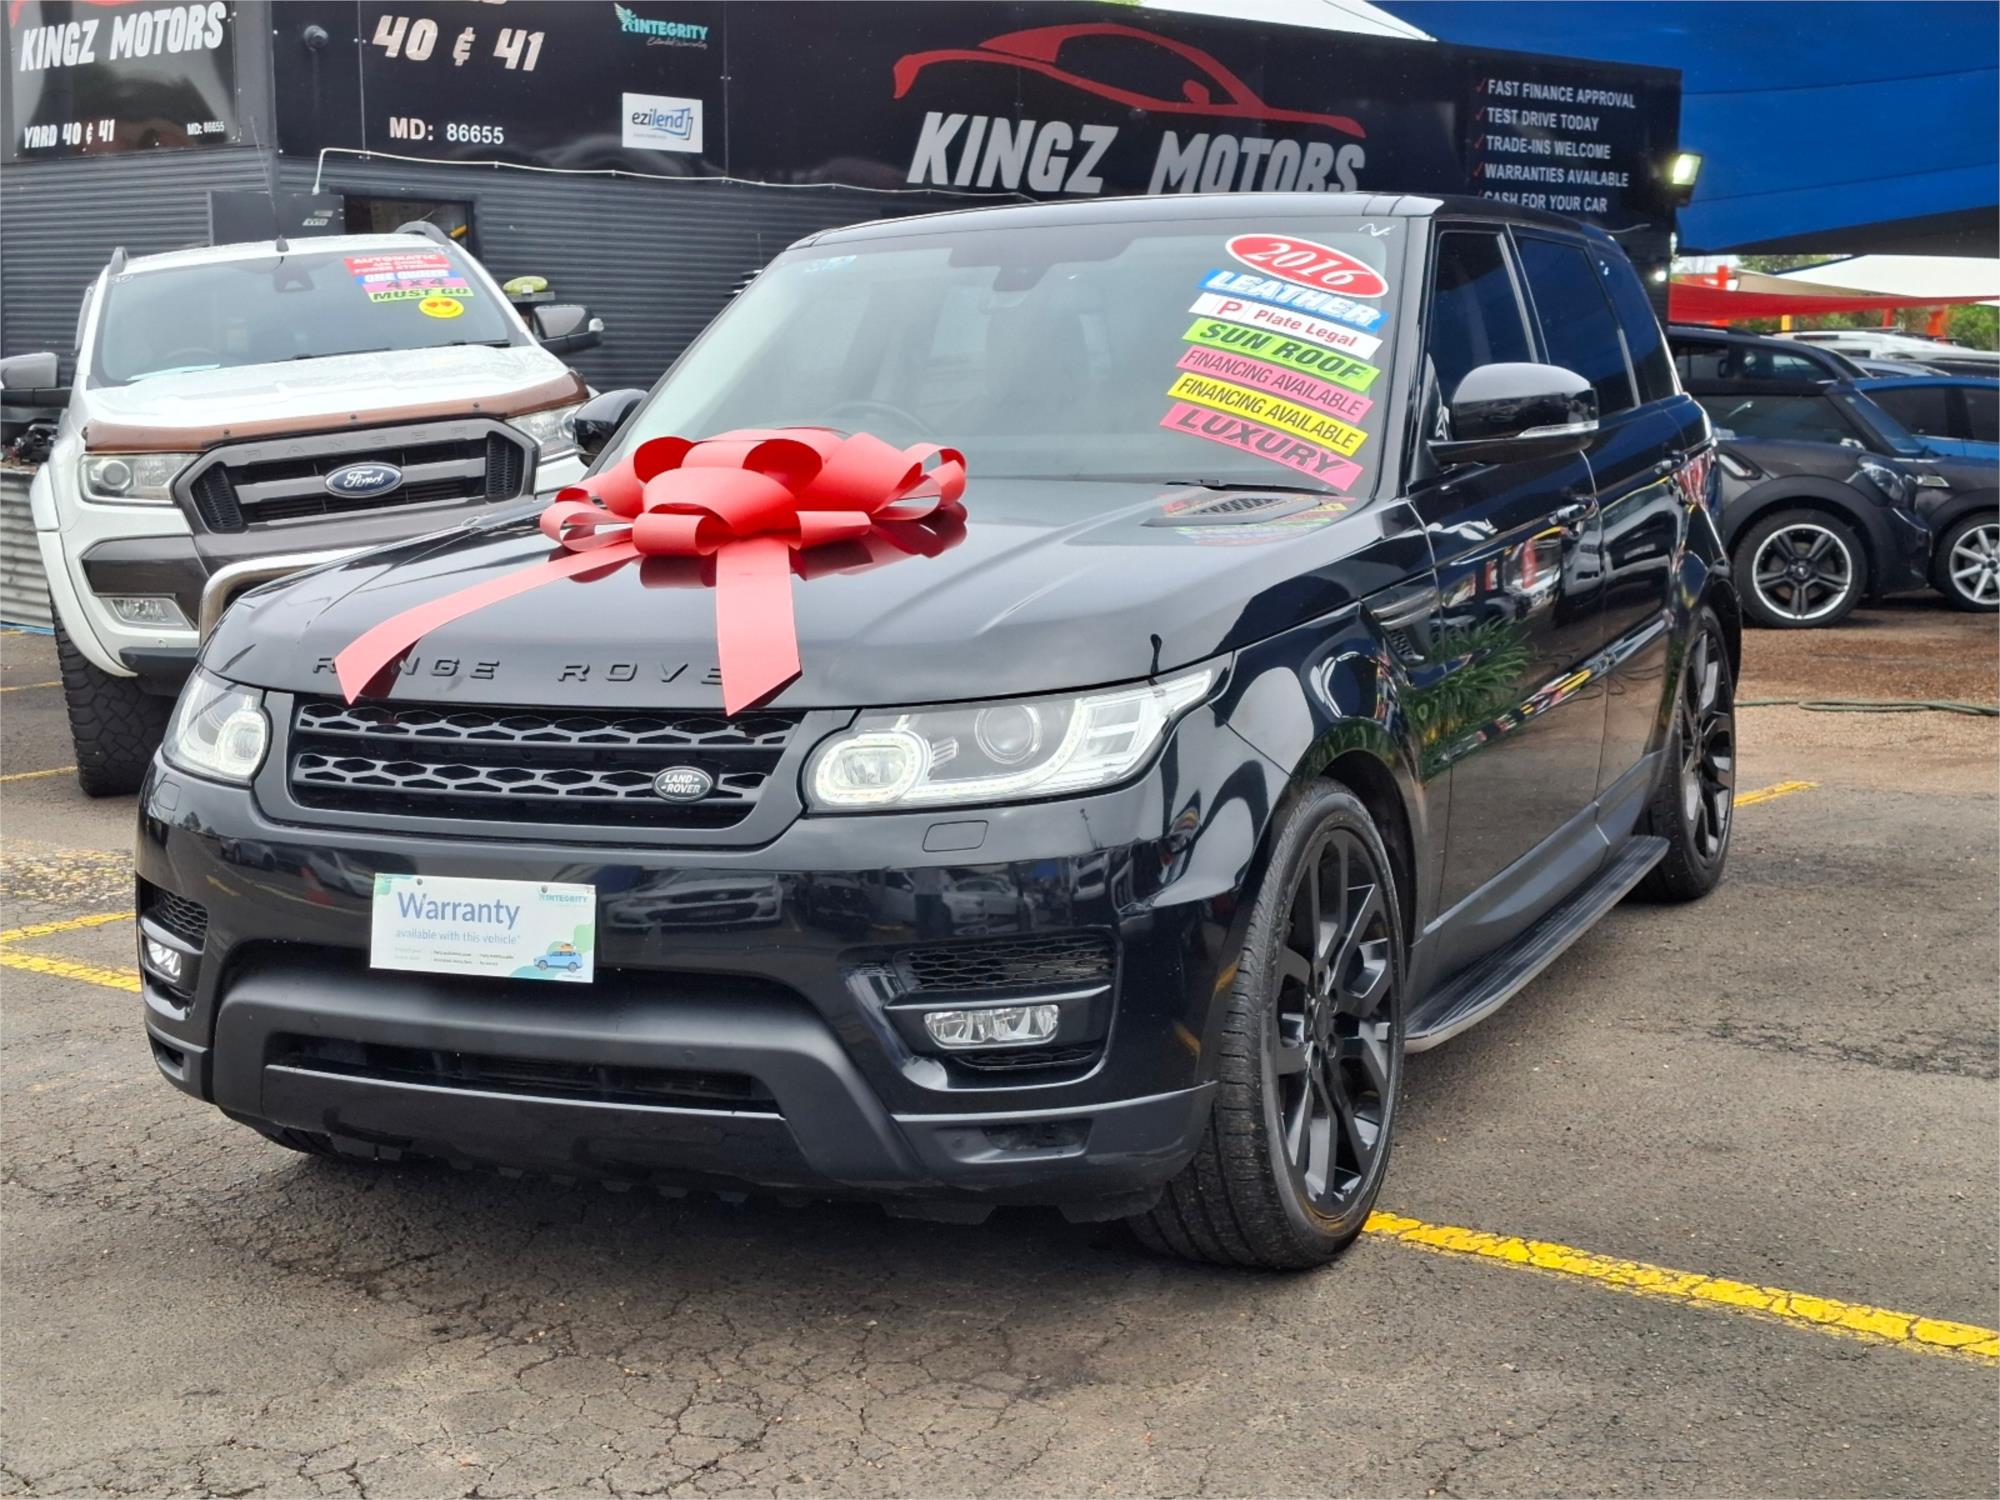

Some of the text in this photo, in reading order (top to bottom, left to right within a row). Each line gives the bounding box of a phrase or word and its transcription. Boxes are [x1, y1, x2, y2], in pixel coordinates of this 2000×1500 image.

[20, 1, 227, 72] KINGZ MOTORS
[372, 15, 439, 61] 40
[492, 28, 546, 72] 41
[634, 17, 709, 40] INTEGRITY
[1487, 79, 1636, 109] FAST FINANCE APPROVAL
[24, 124, 58, 149] YARD
[62, 122, 82, 145] 40
[98, 118, 116, 142] 41
[389, 116, 505, 145] MD: 86655
[631, 107, 686, 129] ezilend
[1486, 107, 1600, 132] TEST DRIVE TODAY
[906, 111, 1366, 195] KINGZ MOTORS
[1486, 135, 1612, 160] TRADE-INS WELCOME
[1484, 162, 1630, 188] WARRANTIES AVAILABLE
[1521, 193, 1546, 209] FOR
[1549, 194, 1582, 212] YOUR
[1583, 196, 1608, 213] CAR
[1242, 242, 1373, 287] 2016
[373, 287, 468, 301] MUST GO
[1204, 270, 1384, 328] LEATHER
[1217, 300, 1359, 348] P Plate Legal
[1199, 323, 1369, 380] SUN ROOF
[1183, 350, 1364, 418] FINANCING AVAILABLE
[1177, 377, 1359, 450] FINANCING AVAILABLE
[1176, 408, 1348, 475] LUXURY
[343, 469, 385, 488] Ford
[312, 655, 723, 686] RNGE ROVE
[397, 890, 521, 931] Warranty
[395, 926, 437, 941] available
[438, 928, 460, 941] with
[463, 930, 481, 943] this
